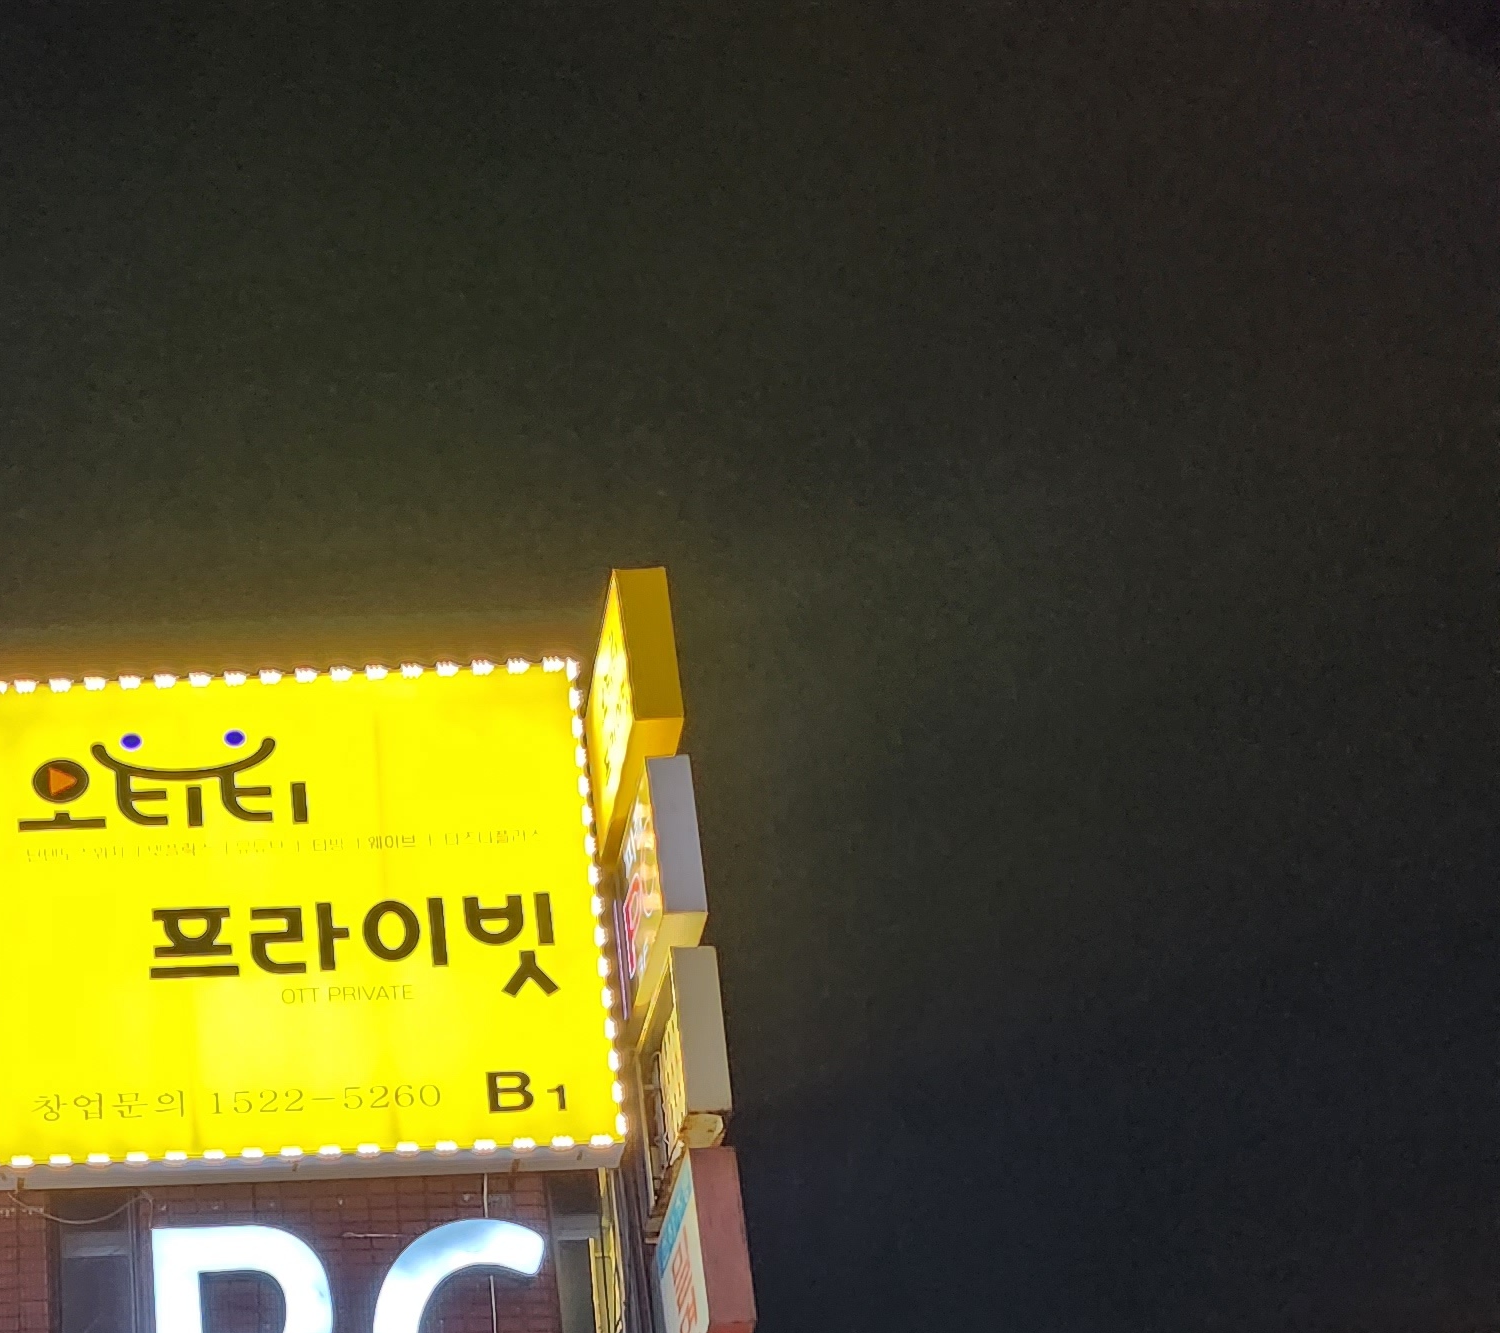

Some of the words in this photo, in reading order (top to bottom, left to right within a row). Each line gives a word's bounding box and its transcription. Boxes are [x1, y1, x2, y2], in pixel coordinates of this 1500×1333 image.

[150, 891, 561, 998] 프라이빗
[281, 985, 323, 1006] OTT
[328, 983, 414, 1004] PRIVATE
[32, 1089, 187, 1123] 창업문의
[211, 1084, 442, 1117] 1522-5260
